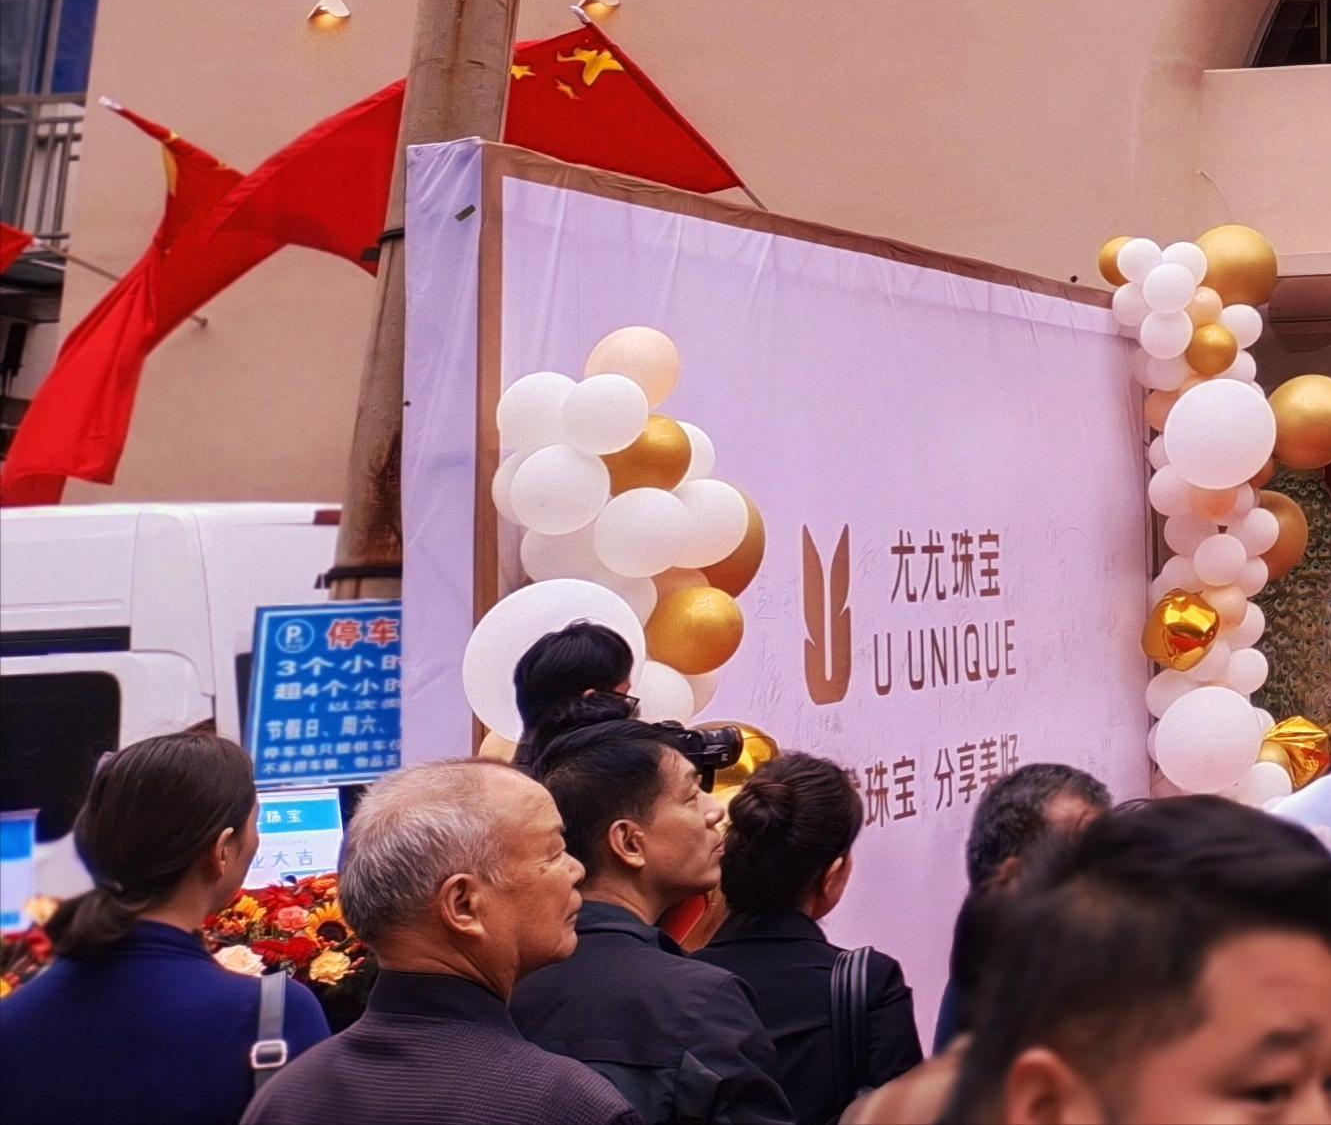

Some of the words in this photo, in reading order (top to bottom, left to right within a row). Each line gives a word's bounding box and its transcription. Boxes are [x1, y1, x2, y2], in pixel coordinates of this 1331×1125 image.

[890, 528, 1001, 604] 尤尤珠宝
[873, 631, 893, 696] U
[907, 619, 1018, 691] UNIQUE
[847, 755, 918, 828] 珠宝
